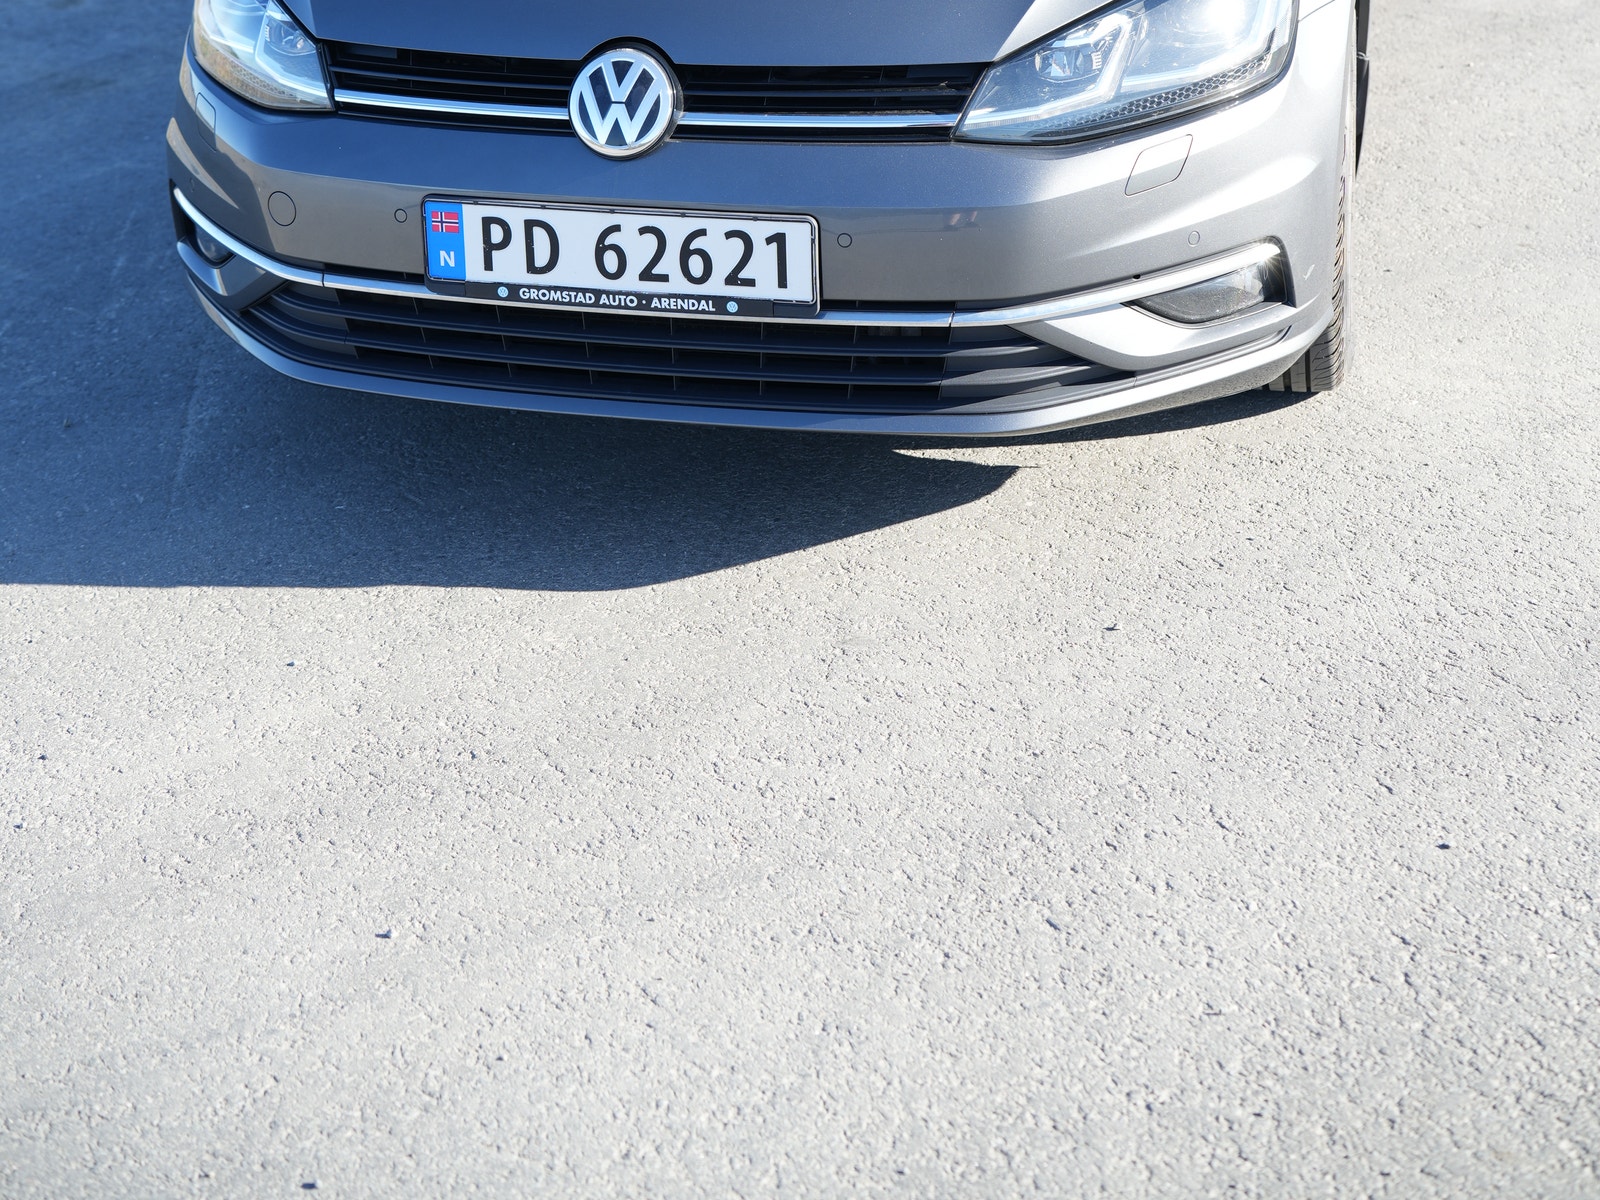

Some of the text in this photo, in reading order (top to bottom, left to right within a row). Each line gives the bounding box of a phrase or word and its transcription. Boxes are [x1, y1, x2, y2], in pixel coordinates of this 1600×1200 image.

[574, 52, 668, 152] VW
[439, 250, 456, 267] N
[482, 216, 788, 289] PD 62621
[519, 287, 716, 313] GROMSTAD AUTO ARENDAL
